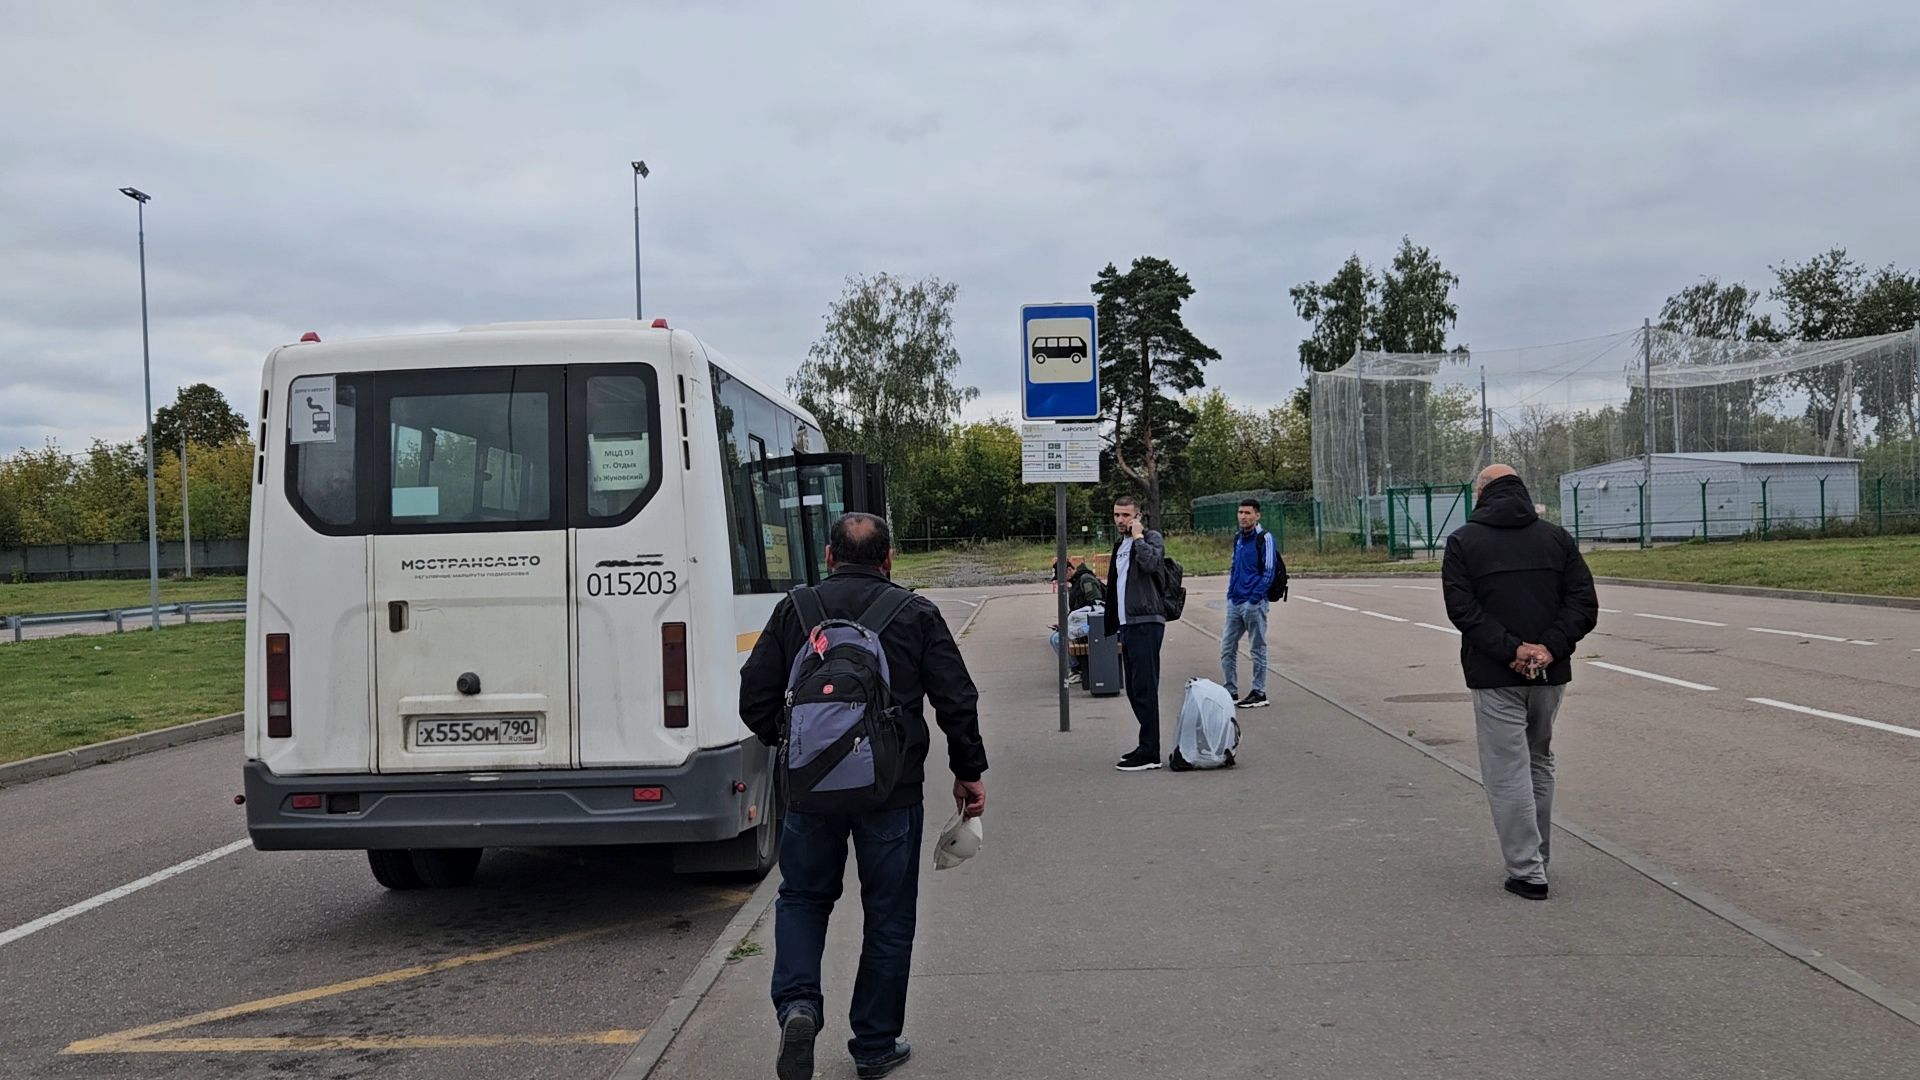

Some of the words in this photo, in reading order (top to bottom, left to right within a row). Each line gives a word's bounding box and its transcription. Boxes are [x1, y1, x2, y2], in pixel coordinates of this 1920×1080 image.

[603, 473, 643, 482] Жуковский
[401, 556, 540, 570] МОСТРАНСАВТО
[586, 570, 677, 597] 015203
